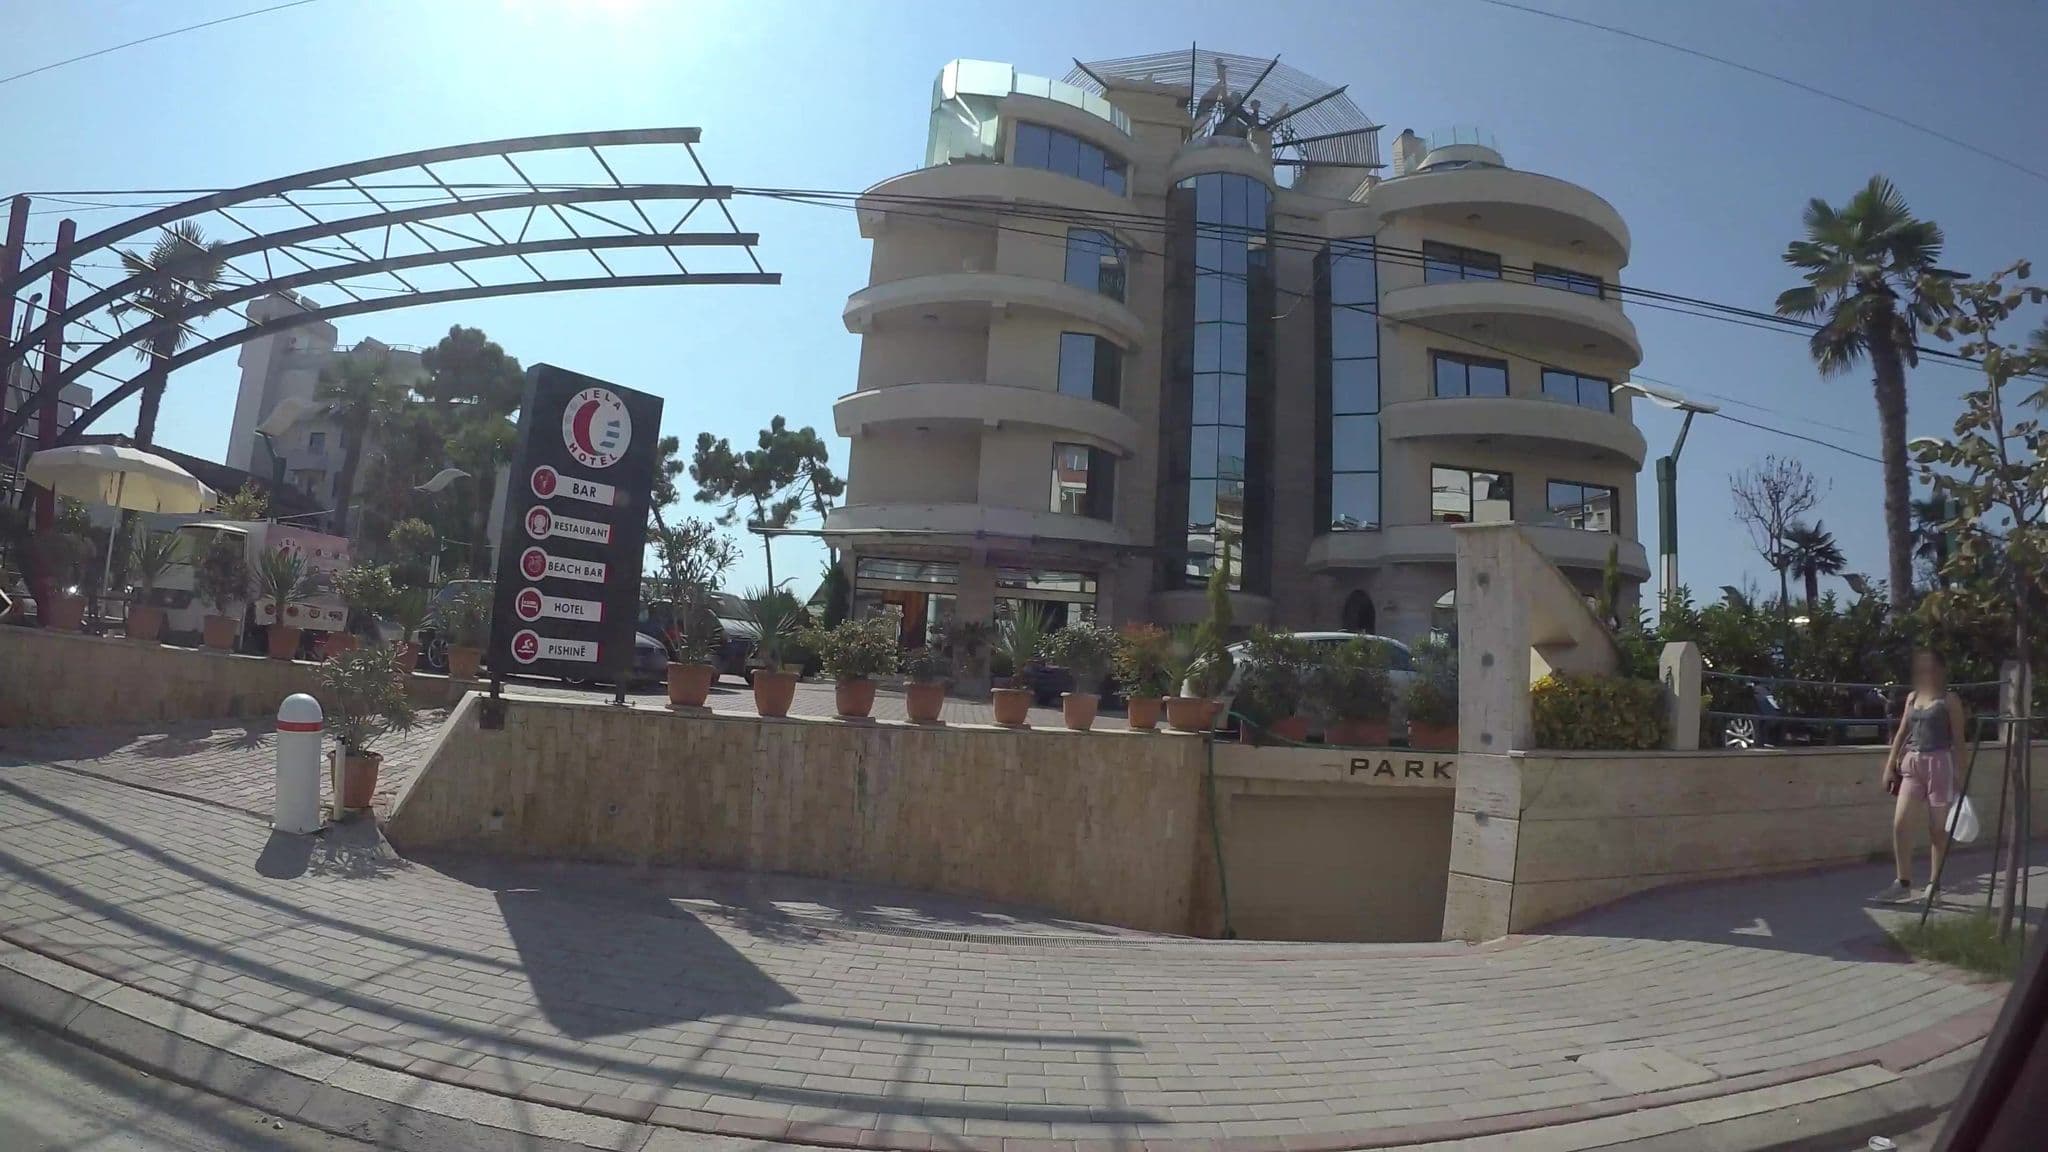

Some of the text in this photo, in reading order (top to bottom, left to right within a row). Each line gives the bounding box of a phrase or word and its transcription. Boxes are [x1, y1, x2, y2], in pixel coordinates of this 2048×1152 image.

[580, 390, 621, 410] VELA
[569, 443, 617, 465] HOTEL
[572, 483, 597, 498] BAR
[554, 521, 608, 538] RESTAURANT
[548, 561, 603, 577] BEACH BAR
[554, 603, 584, 615] HOTEL
[548, 645, 586, 657] PISHINË
[1350, 758, 1454, 779] PARK
